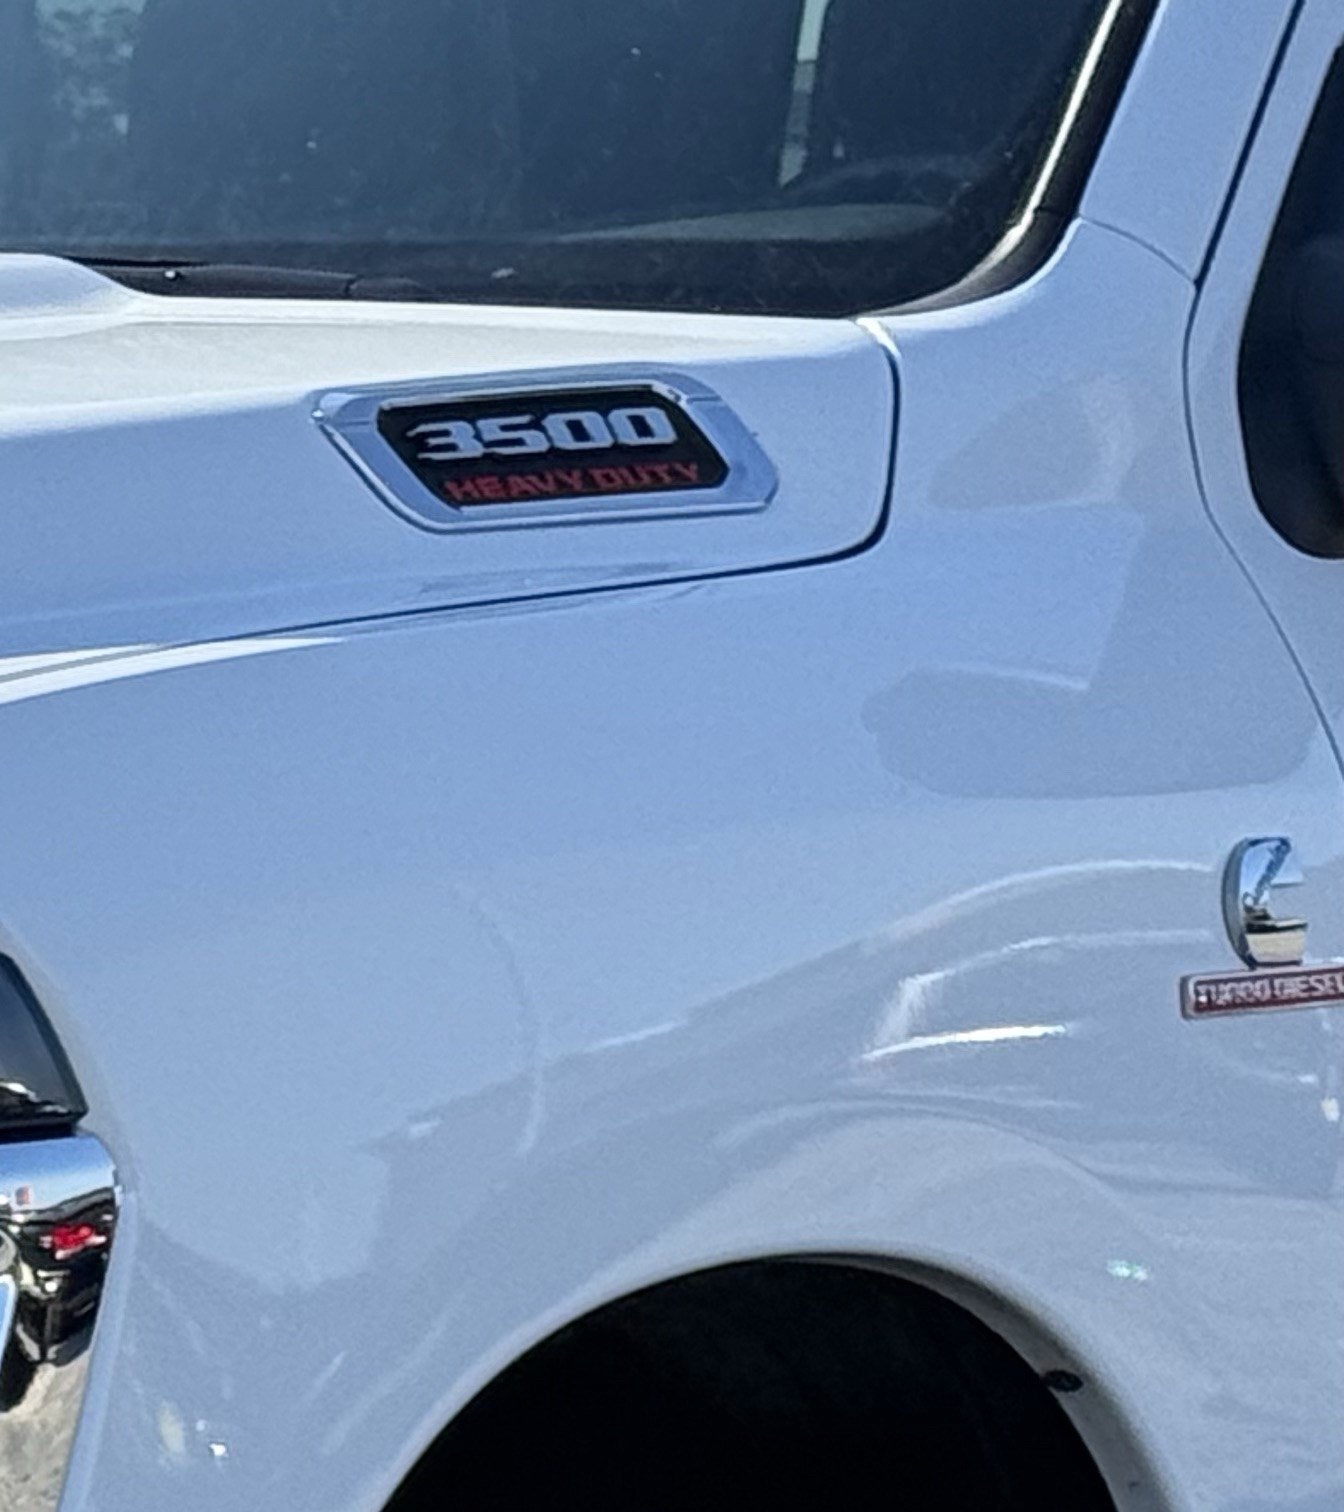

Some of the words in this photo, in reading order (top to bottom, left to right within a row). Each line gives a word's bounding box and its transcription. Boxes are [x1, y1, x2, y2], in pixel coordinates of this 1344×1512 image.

[407, 407, 678, 460] 3500
[444, 469, 584, 500] HEAVY
[593, 462, 700, 488] DUTY
